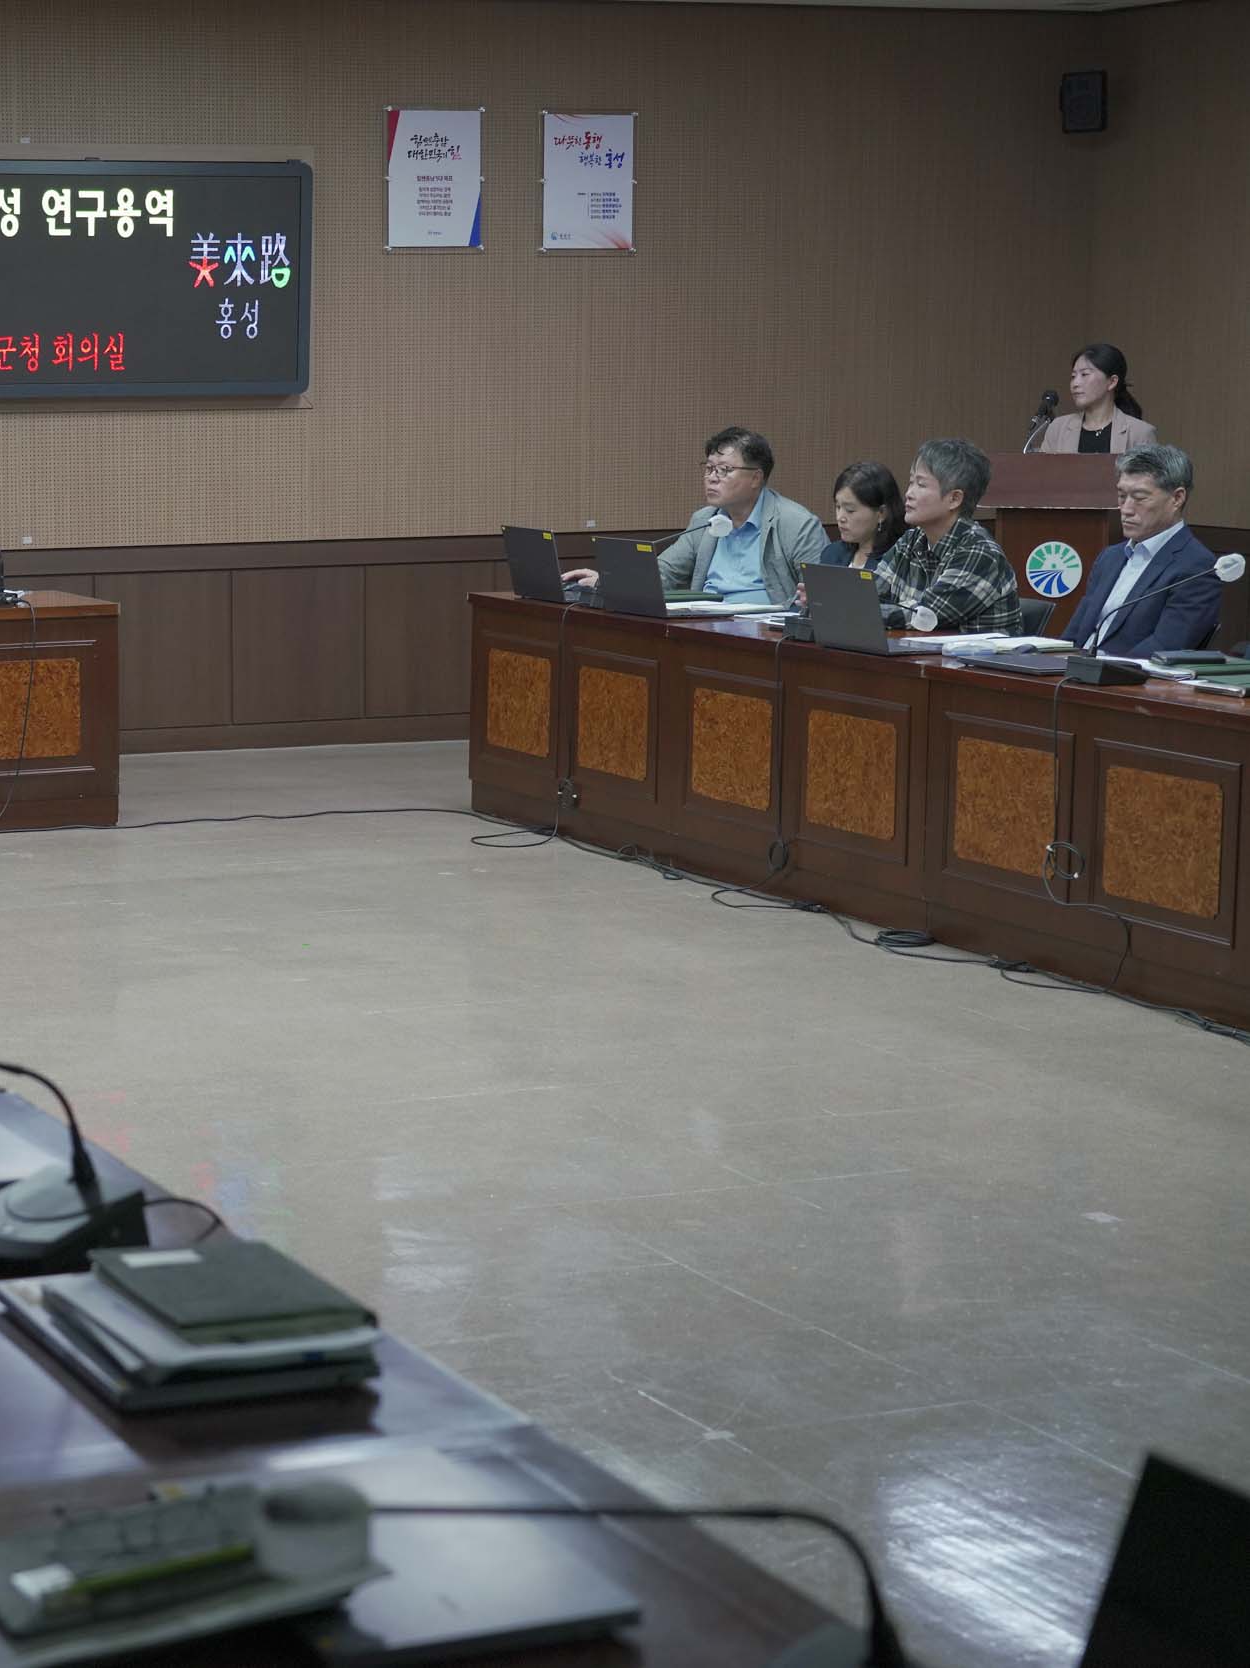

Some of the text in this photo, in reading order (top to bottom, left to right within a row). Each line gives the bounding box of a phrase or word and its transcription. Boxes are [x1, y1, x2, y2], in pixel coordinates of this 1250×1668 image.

[578, 149, 625, 168] 행복한 홍성
[582, 131, 603, 150] 동행
[41, 187, 174, 238] 연구용역
[215, 297, 260, 340] 홍성
[51, 332, 126, 371] 회의실
